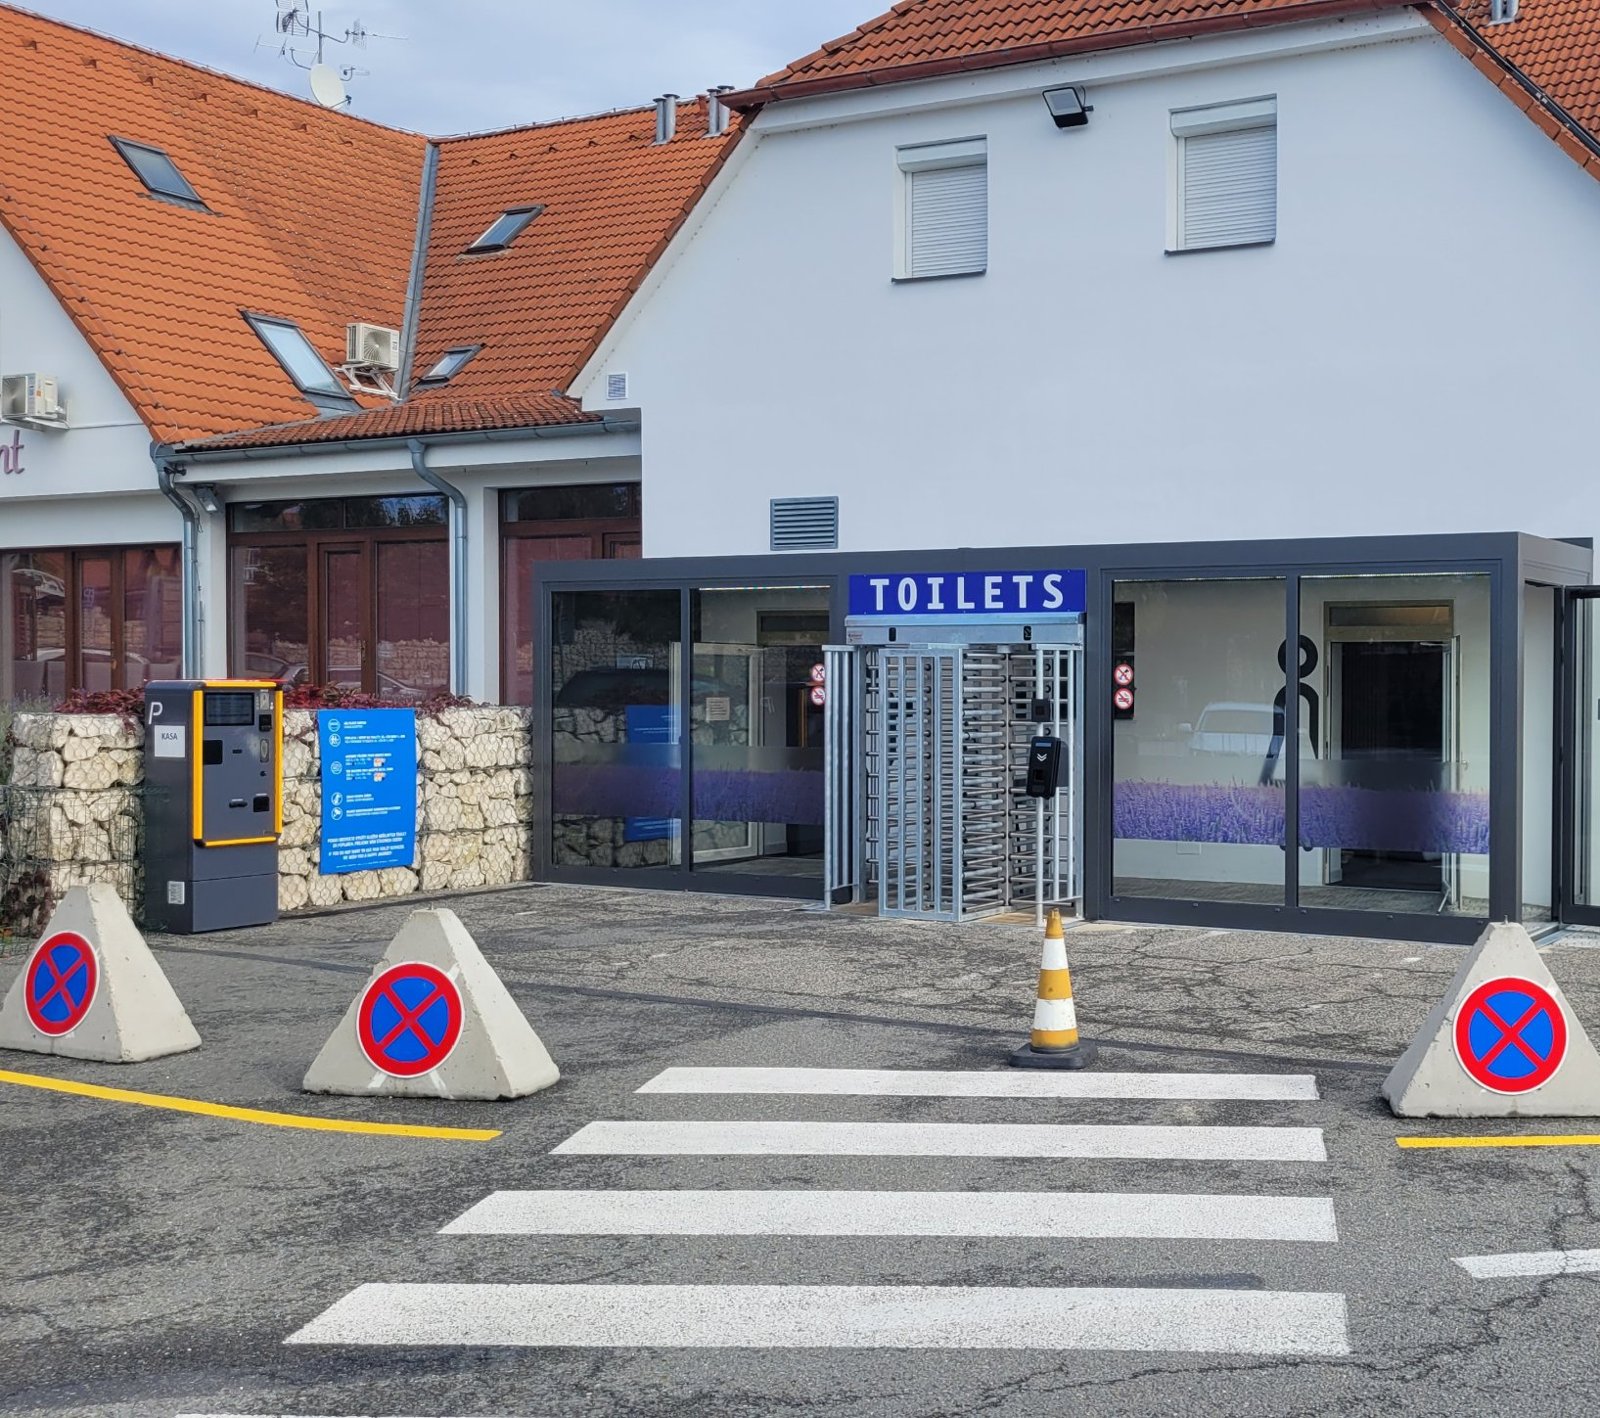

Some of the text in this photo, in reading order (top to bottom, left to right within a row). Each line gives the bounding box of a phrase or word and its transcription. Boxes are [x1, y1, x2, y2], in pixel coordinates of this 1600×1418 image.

[869, 573, 1064, 612] TOILETS
[148, 701, 163, 725] P
[161, 732, 178, 741] KASA
